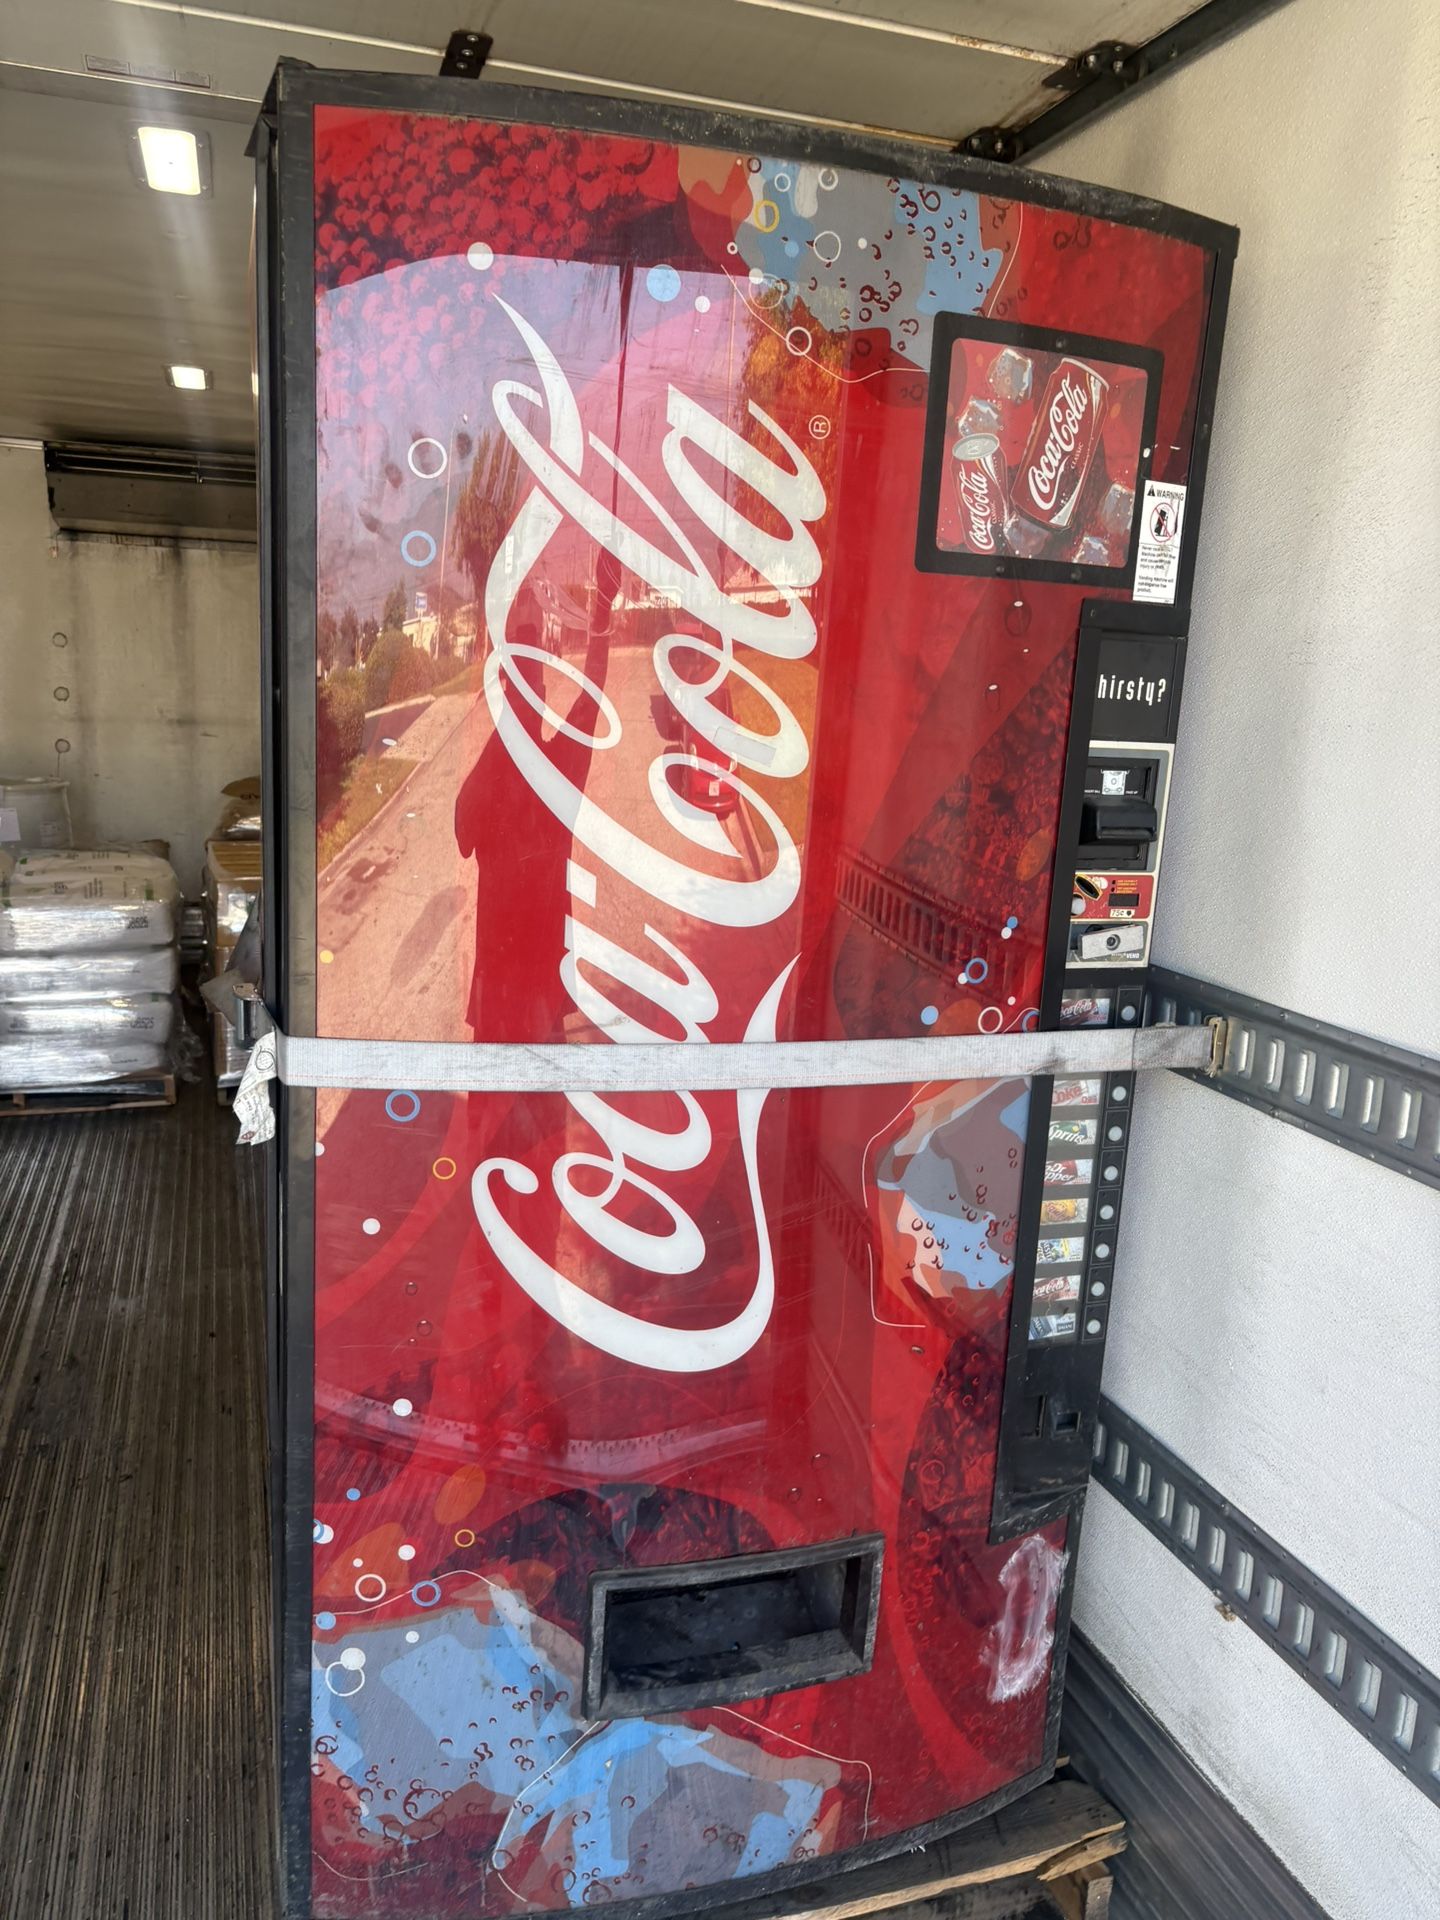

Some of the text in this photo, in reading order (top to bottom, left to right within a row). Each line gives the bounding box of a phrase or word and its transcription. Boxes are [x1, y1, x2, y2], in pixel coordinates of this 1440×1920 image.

[1028, 371, 1088, 510] Coca-Cola
[959, 463, 994, 549] Coca-Cola
[1156, 489, 1185, 501] WARNING
[1097, 674, 1166, 706] hirsty?
[471, 293, 833, 1372] Coca-Cola
[1048, 1124, 1084, 1145] Sprite
[1045, 1171, 1074, 1182] pper
